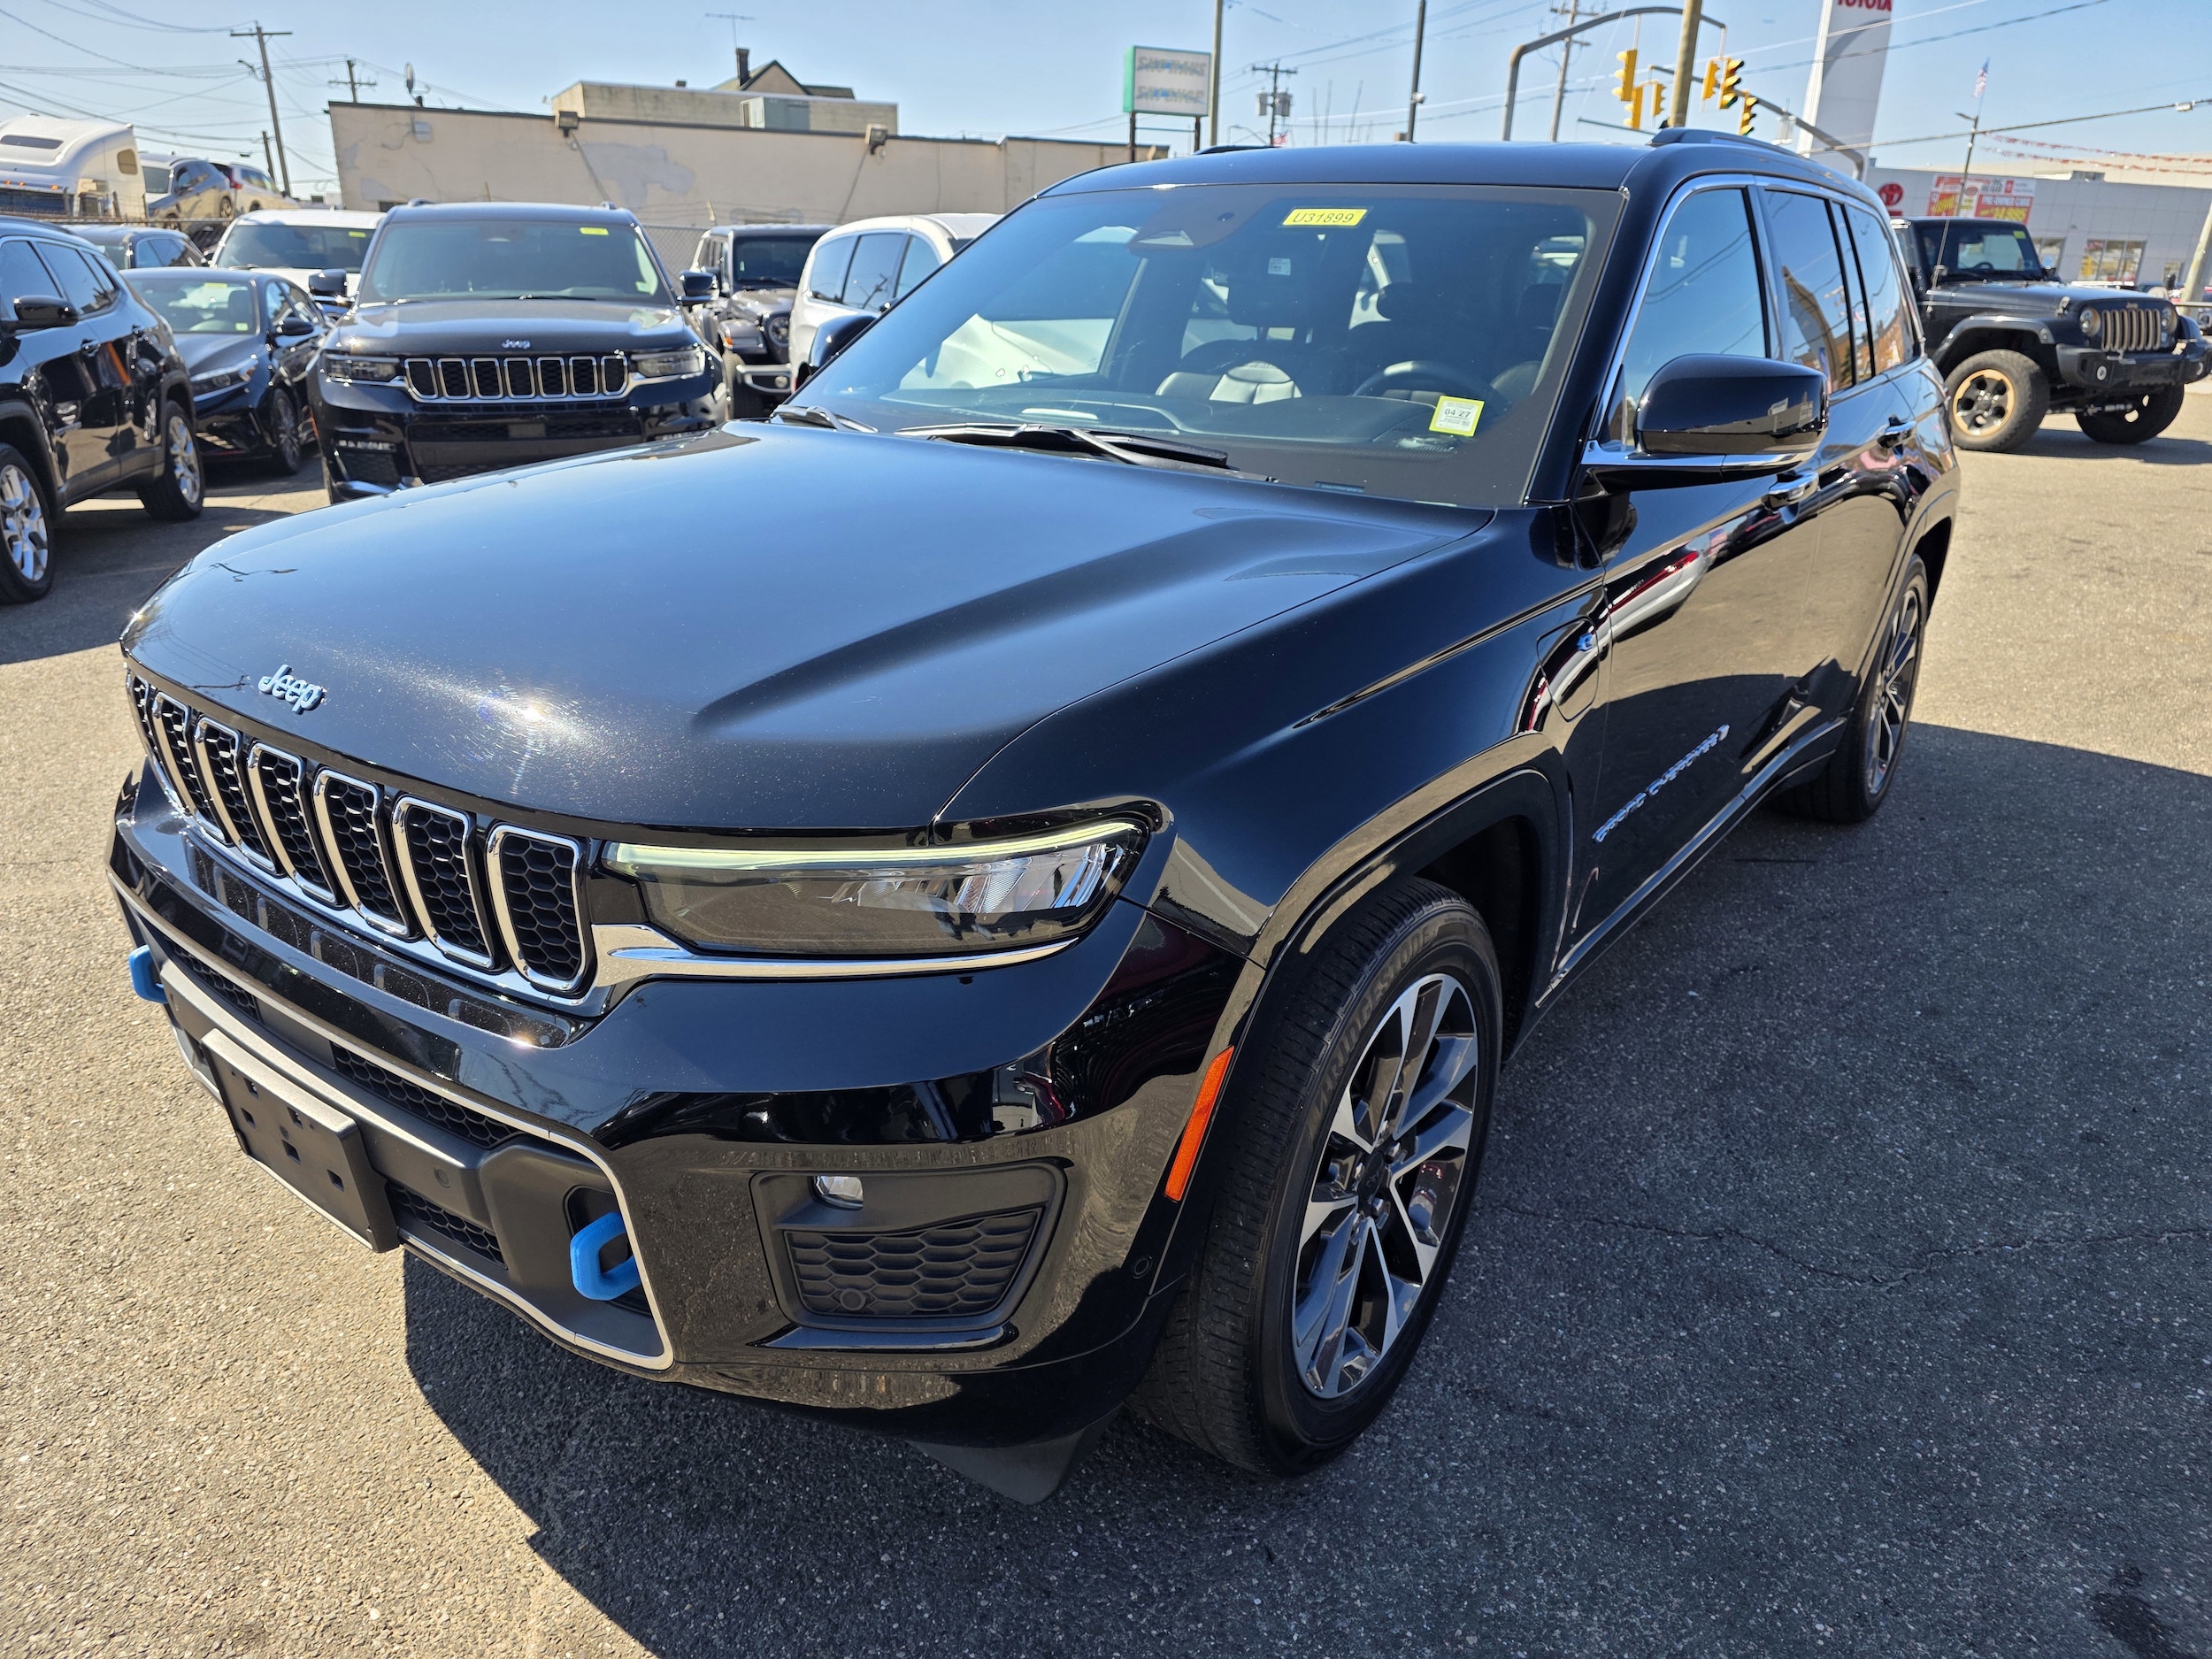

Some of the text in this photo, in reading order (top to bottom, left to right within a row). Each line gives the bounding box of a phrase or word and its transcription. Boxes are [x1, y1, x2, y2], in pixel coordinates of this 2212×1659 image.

[1293, 212, 1355, 223] U31899
[502, 339, 531, 349] Jeep
[258, 664, 324, 714] Jeep
